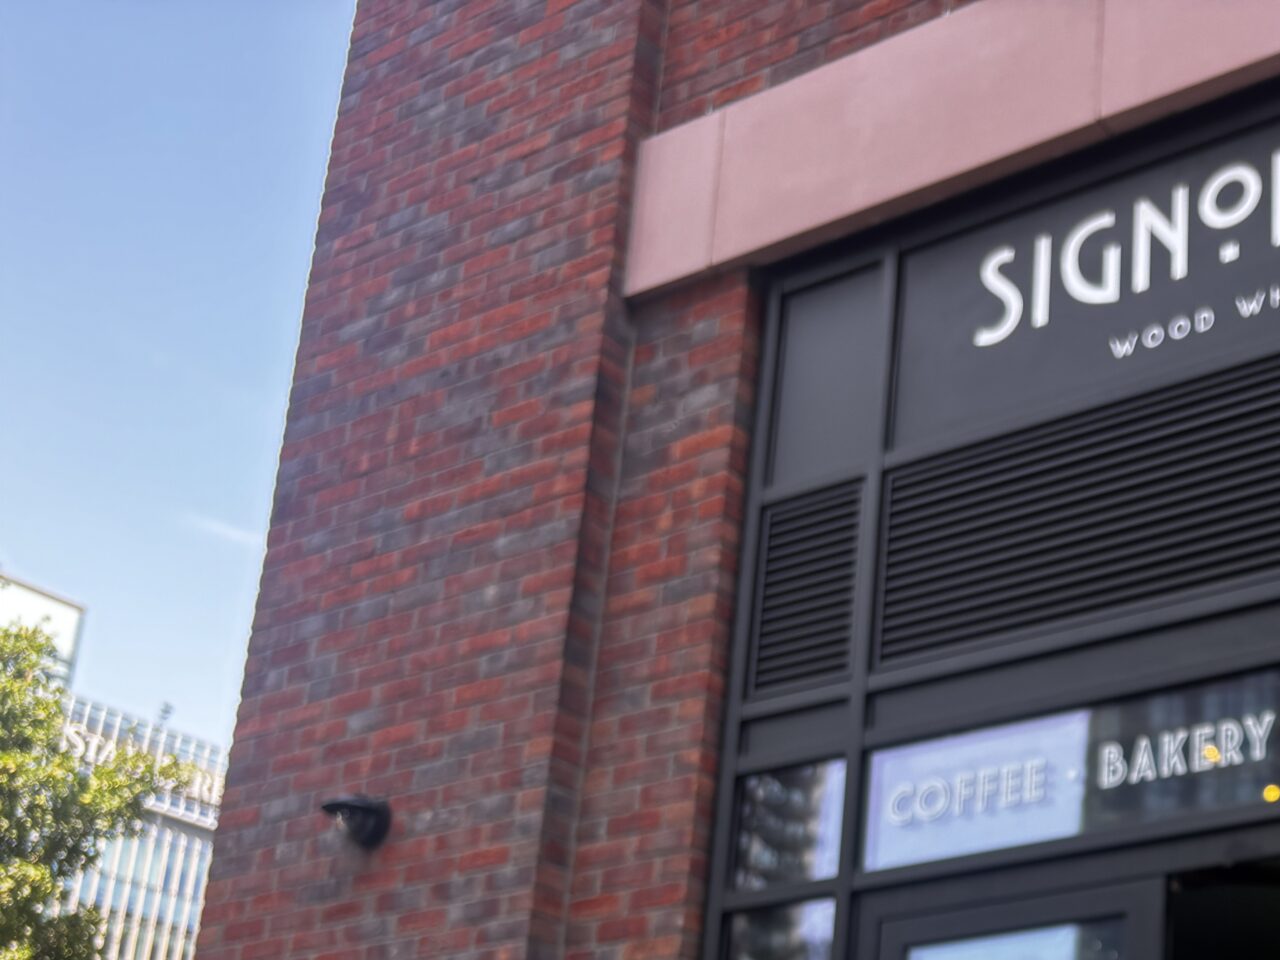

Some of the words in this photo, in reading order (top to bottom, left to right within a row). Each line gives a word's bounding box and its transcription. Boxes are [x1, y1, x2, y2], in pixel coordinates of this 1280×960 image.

[1108, 306, 1215, 359] WOOD
[888, 757, 1048, 826] COFFEE
[1098, 712, 1275, 789] BAKERY
